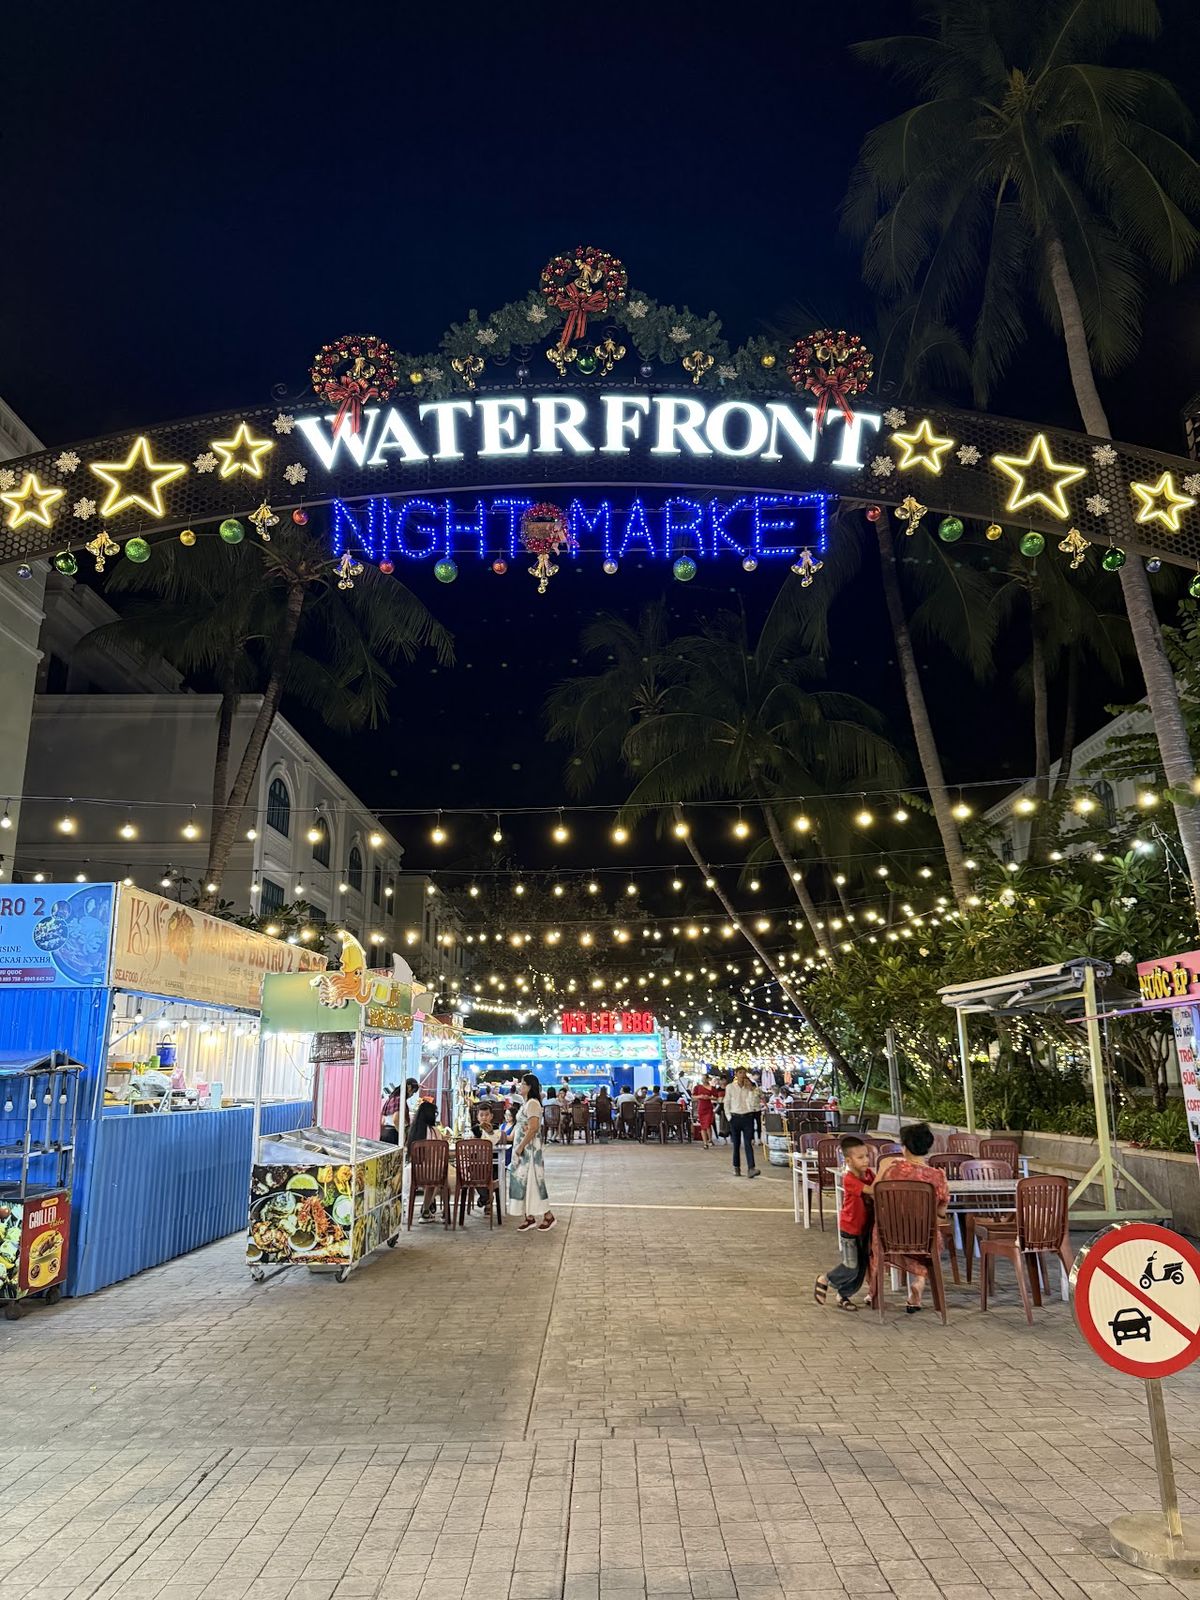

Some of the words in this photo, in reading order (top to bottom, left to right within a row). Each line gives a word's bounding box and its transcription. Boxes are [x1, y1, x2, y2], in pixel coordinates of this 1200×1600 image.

[296, 395, 882, 473] WATERFRONT
[332, 496, 531, 560] NIGHT
[571, 493, 838, 560] MARKET
[33, 897, 45, 916] 2
[287, 948, 294, 973] 2
[115, 968, 138, 983] SEAFOOD
[1138, 966, 1172, 1001] NƯỚC
[621, 1012, 654, 1034] BBQ
[29, 1206, 57, 1229] GRILLED
